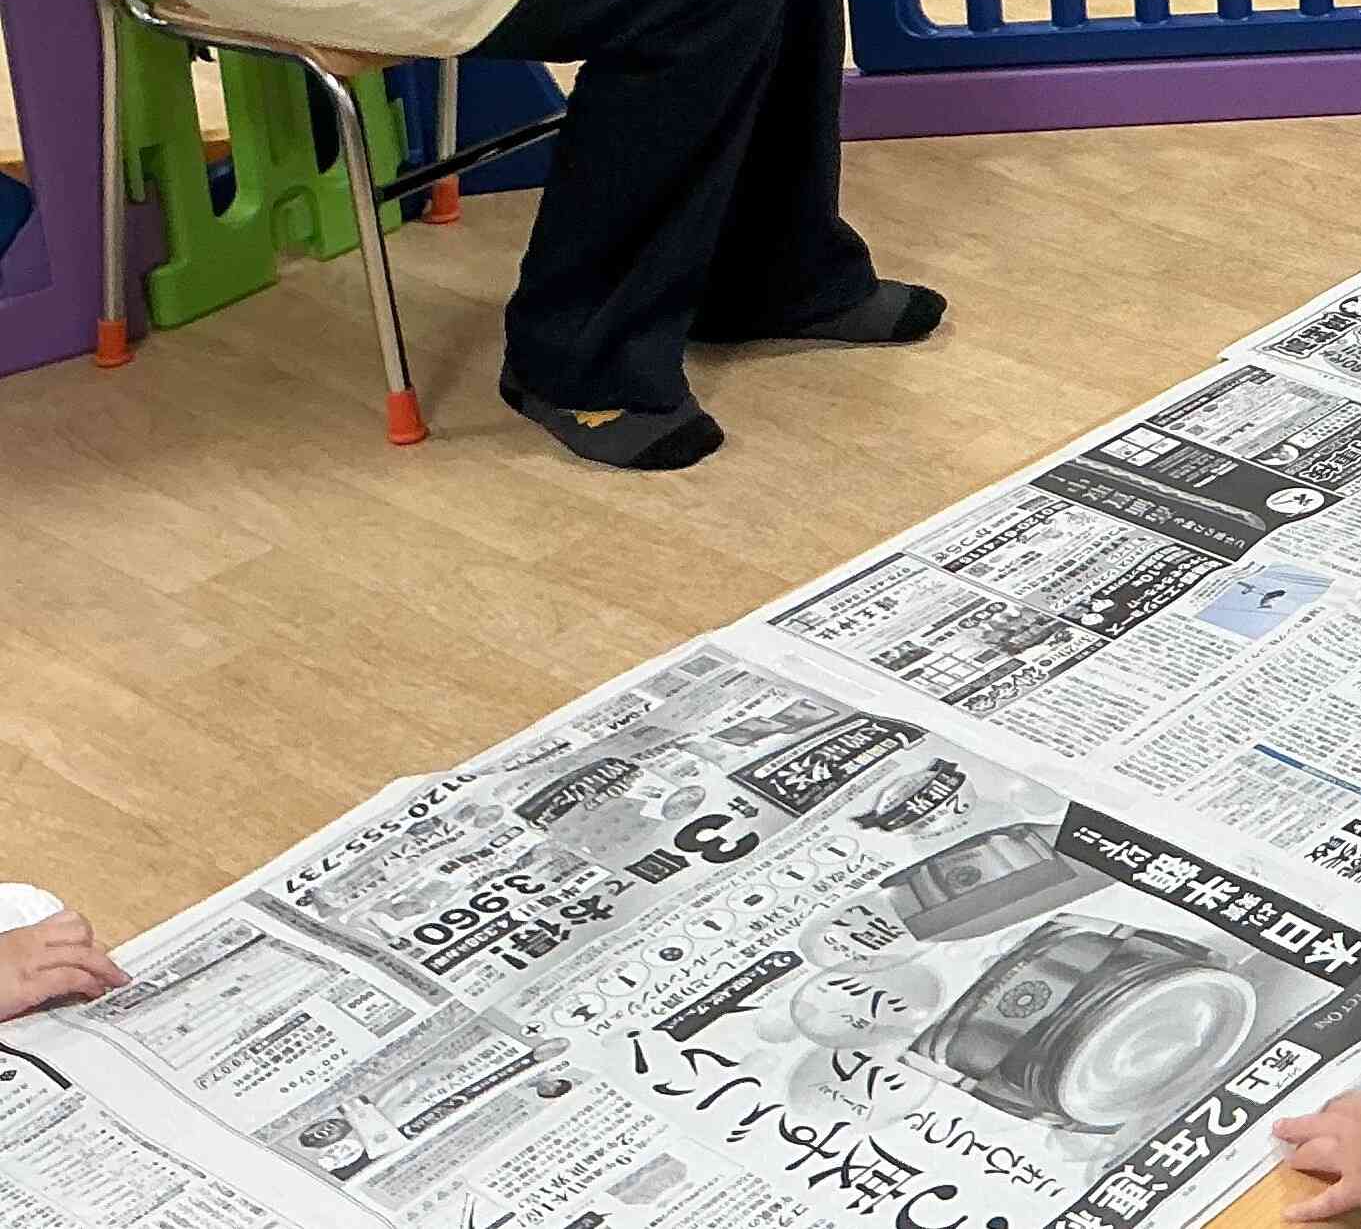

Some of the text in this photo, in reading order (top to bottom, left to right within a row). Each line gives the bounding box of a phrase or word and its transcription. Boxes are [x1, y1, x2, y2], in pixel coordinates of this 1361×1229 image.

[276, 770, 480, 894] 0120-555-737
[818, 968, 916, 1024] シミ
[811, 1043, 915, 1104] シワ
[1229, 1045, 1307, 1095] 売上
[903, 1110, 1068, 1198] これひとつで
